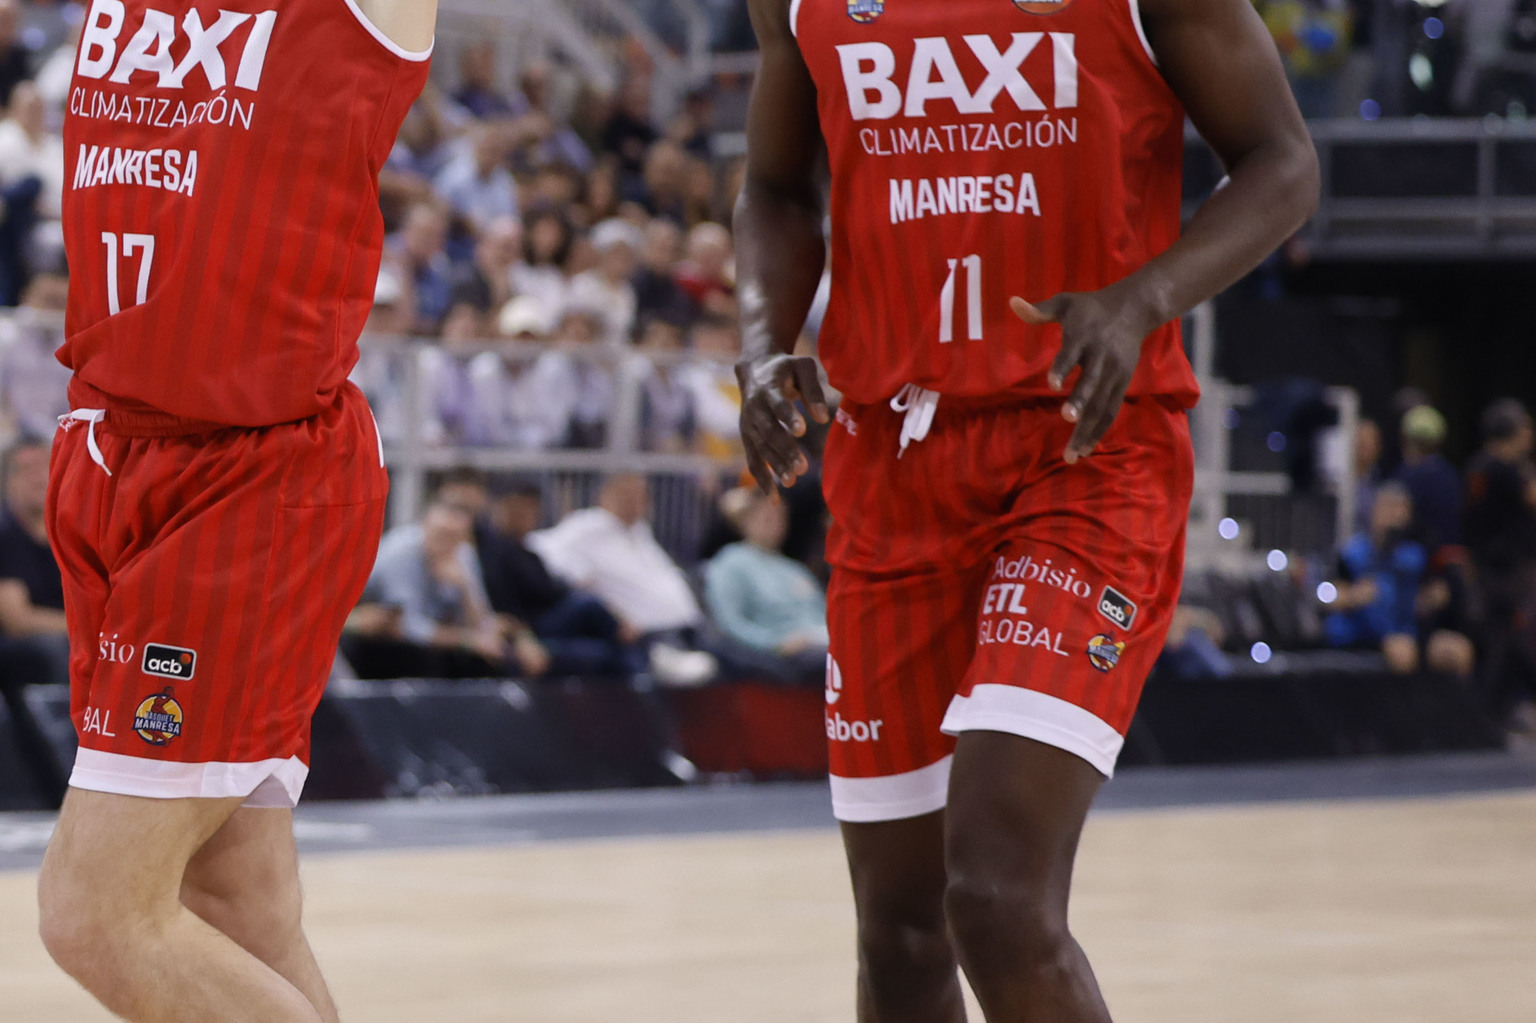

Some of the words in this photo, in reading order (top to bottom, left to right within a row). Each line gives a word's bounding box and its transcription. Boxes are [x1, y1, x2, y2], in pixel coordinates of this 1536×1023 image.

[835, 32, 1079, 121] BAXI
[70, 88, 255, 130] CLIMATIZACIÓN
[859, 115, 1078, 156] CLIMATIZACIÓN
[73, 143, 198, 197] MANRESA
[889, 173, 1041, 224] MANRESA
[101, 231, 155, 317] 17
[938, 254, 983, 343] 11
[992, 556, 1091, 598] Adbisio
[983, 583, 1028, 615] ETL
[1102, 600, 1125, 622] acb
[98, 632, 135, 664] sio
[979, 619, 1070, 657] GLOBAL
[148, 657, 183, 675] acb
[135, 718, 180, 734] MANRESA
[825, 709, 883, 742] abor
